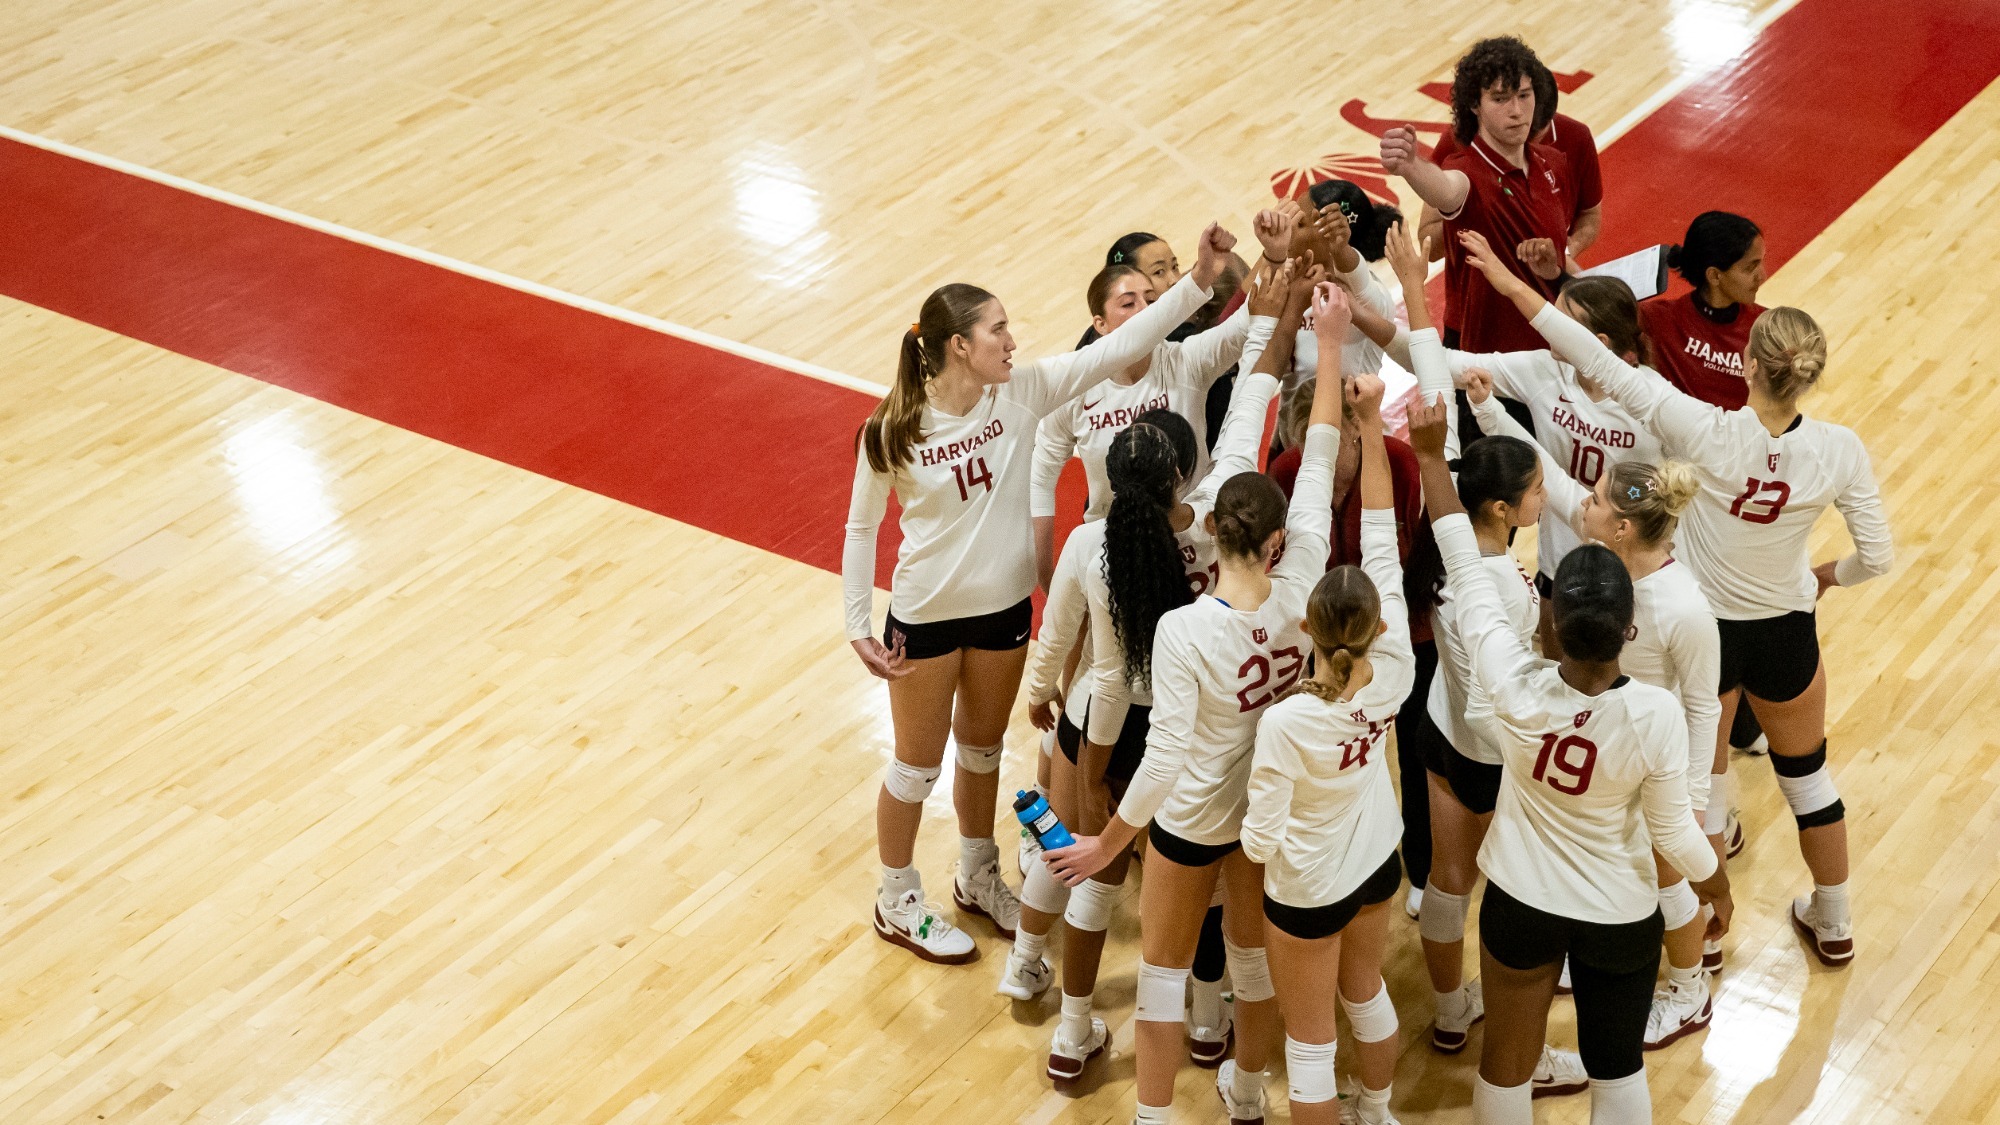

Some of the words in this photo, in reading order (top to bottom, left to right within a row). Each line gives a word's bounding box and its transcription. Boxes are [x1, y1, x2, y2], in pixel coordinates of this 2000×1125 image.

[1684, 337, 1743, 369] HAVA
[920, 419, 1004, 467] HARVARD
[1552, 407, 1635, 448] HARVARD
[951, 457, 993, 502] 14
[1570, 438, 1604, 487] 10
[1729, 477, 1791, 525] 13
[1236, 646, 1304, 713] 23
[1532, 733, 1598, 796] 19
